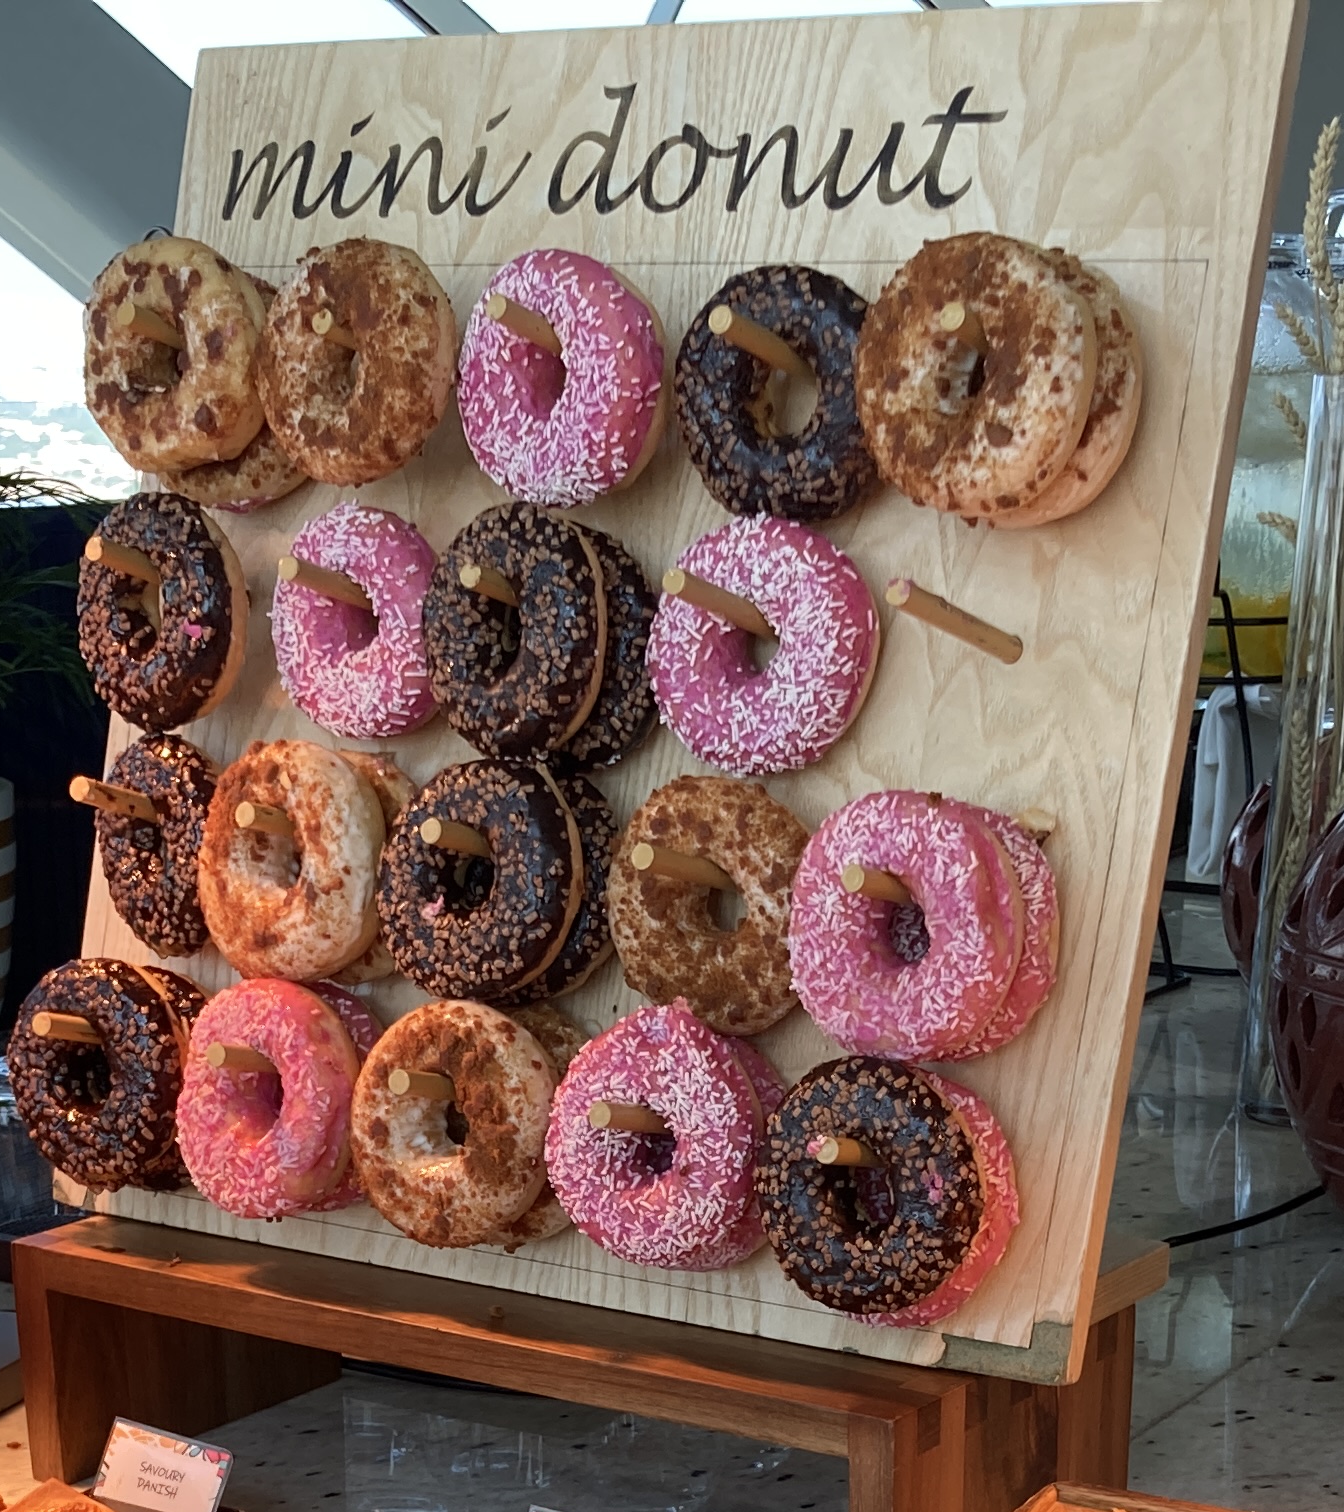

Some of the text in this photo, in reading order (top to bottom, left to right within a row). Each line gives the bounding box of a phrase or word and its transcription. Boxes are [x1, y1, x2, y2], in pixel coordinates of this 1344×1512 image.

[222, 82, 1008, 221] mini donut
[139, 1460, 186, 1483] SAVOURY
[137, 1476, 179, 1499] DANISH
